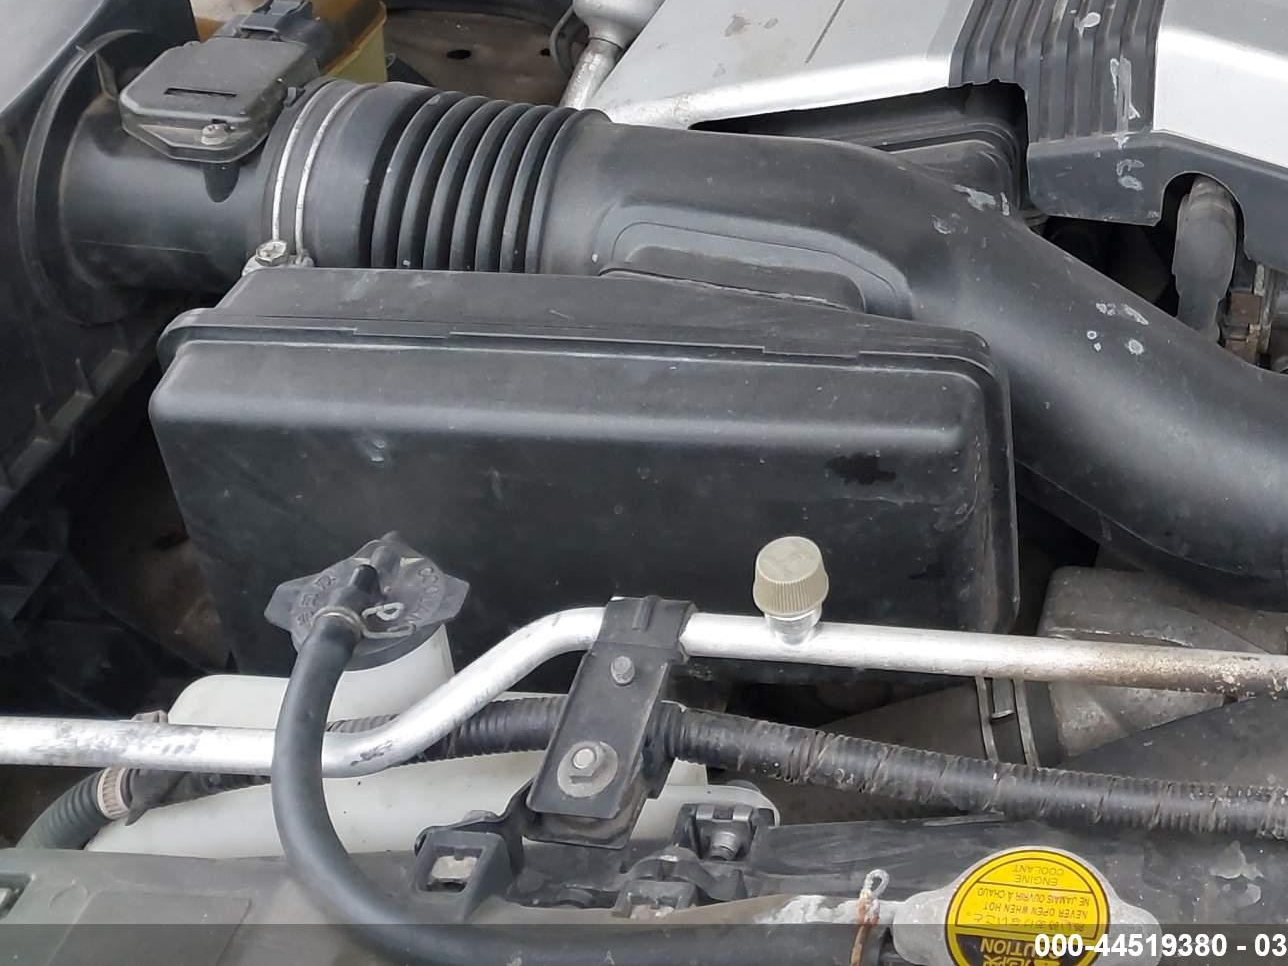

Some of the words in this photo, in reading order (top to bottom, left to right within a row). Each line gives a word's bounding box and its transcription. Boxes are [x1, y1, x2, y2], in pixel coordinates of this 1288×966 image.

[1014, 864, 1065, 876] COOLANT
[1014, 874, 1058, 886] ENGINE
[1015, 892, 1045, 904] OUVRIR
[1047, 895, 1079, 905] JAMAIS
[1080, 897, 1090, 906] NE
[1003, 903, 1029, 914] WHEN
[1032, 907, 1058, 917] OPEN
[1058, 909, 1088, 920] NEVER
